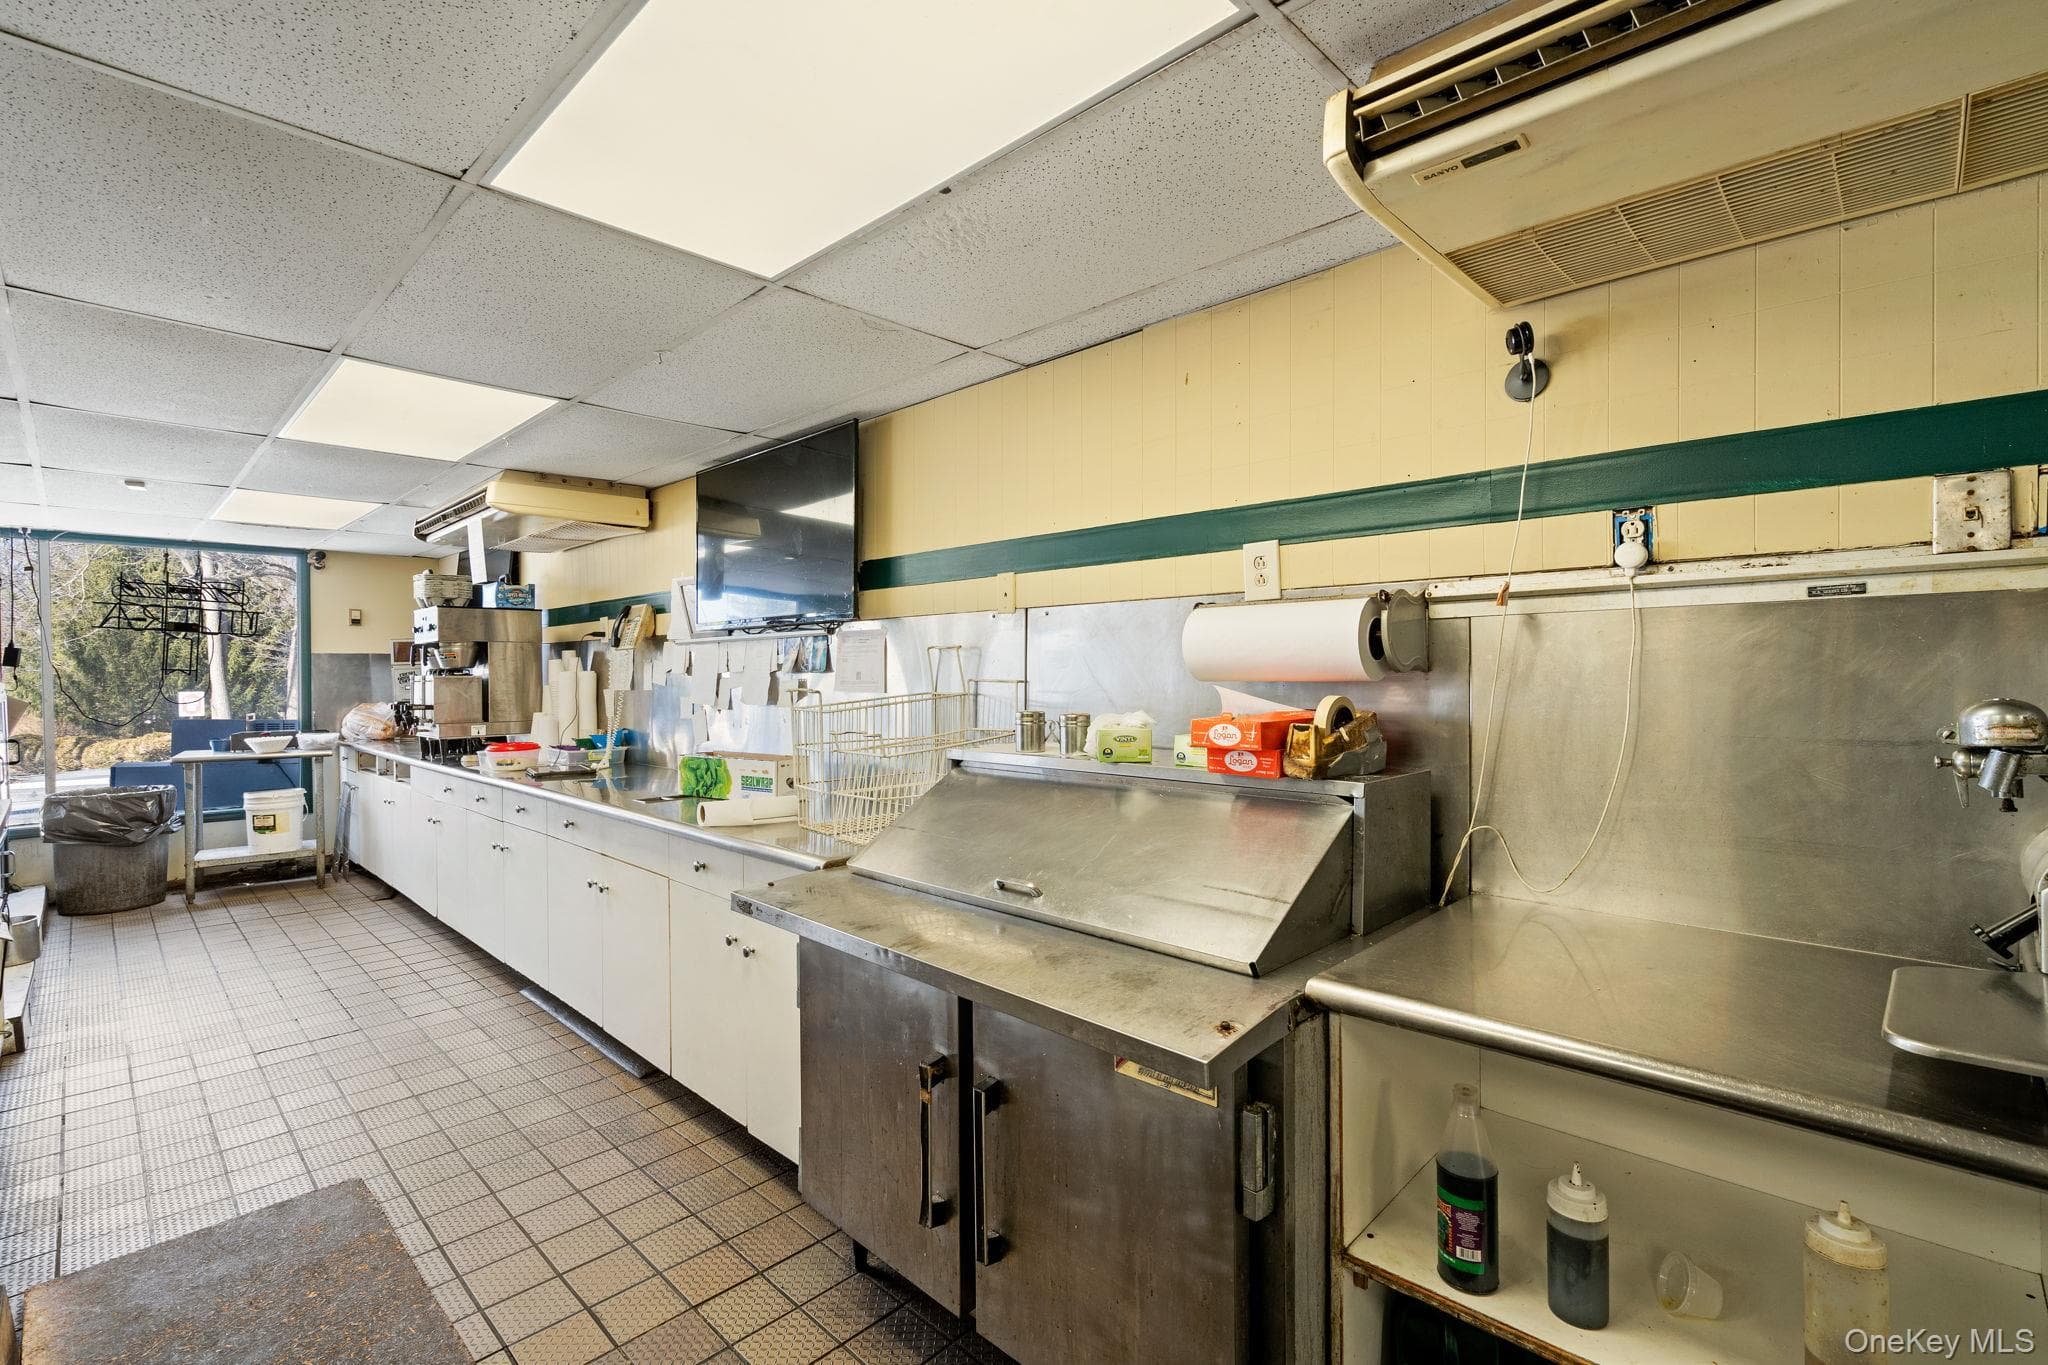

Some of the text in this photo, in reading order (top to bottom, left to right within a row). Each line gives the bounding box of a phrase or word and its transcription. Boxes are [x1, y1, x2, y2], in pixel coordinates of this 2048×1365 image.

[1423, 165, 1459, 181] SANYO
[1213, 728, 1238, 742] Logan
[1228, 754, 1255, 767] Logan
